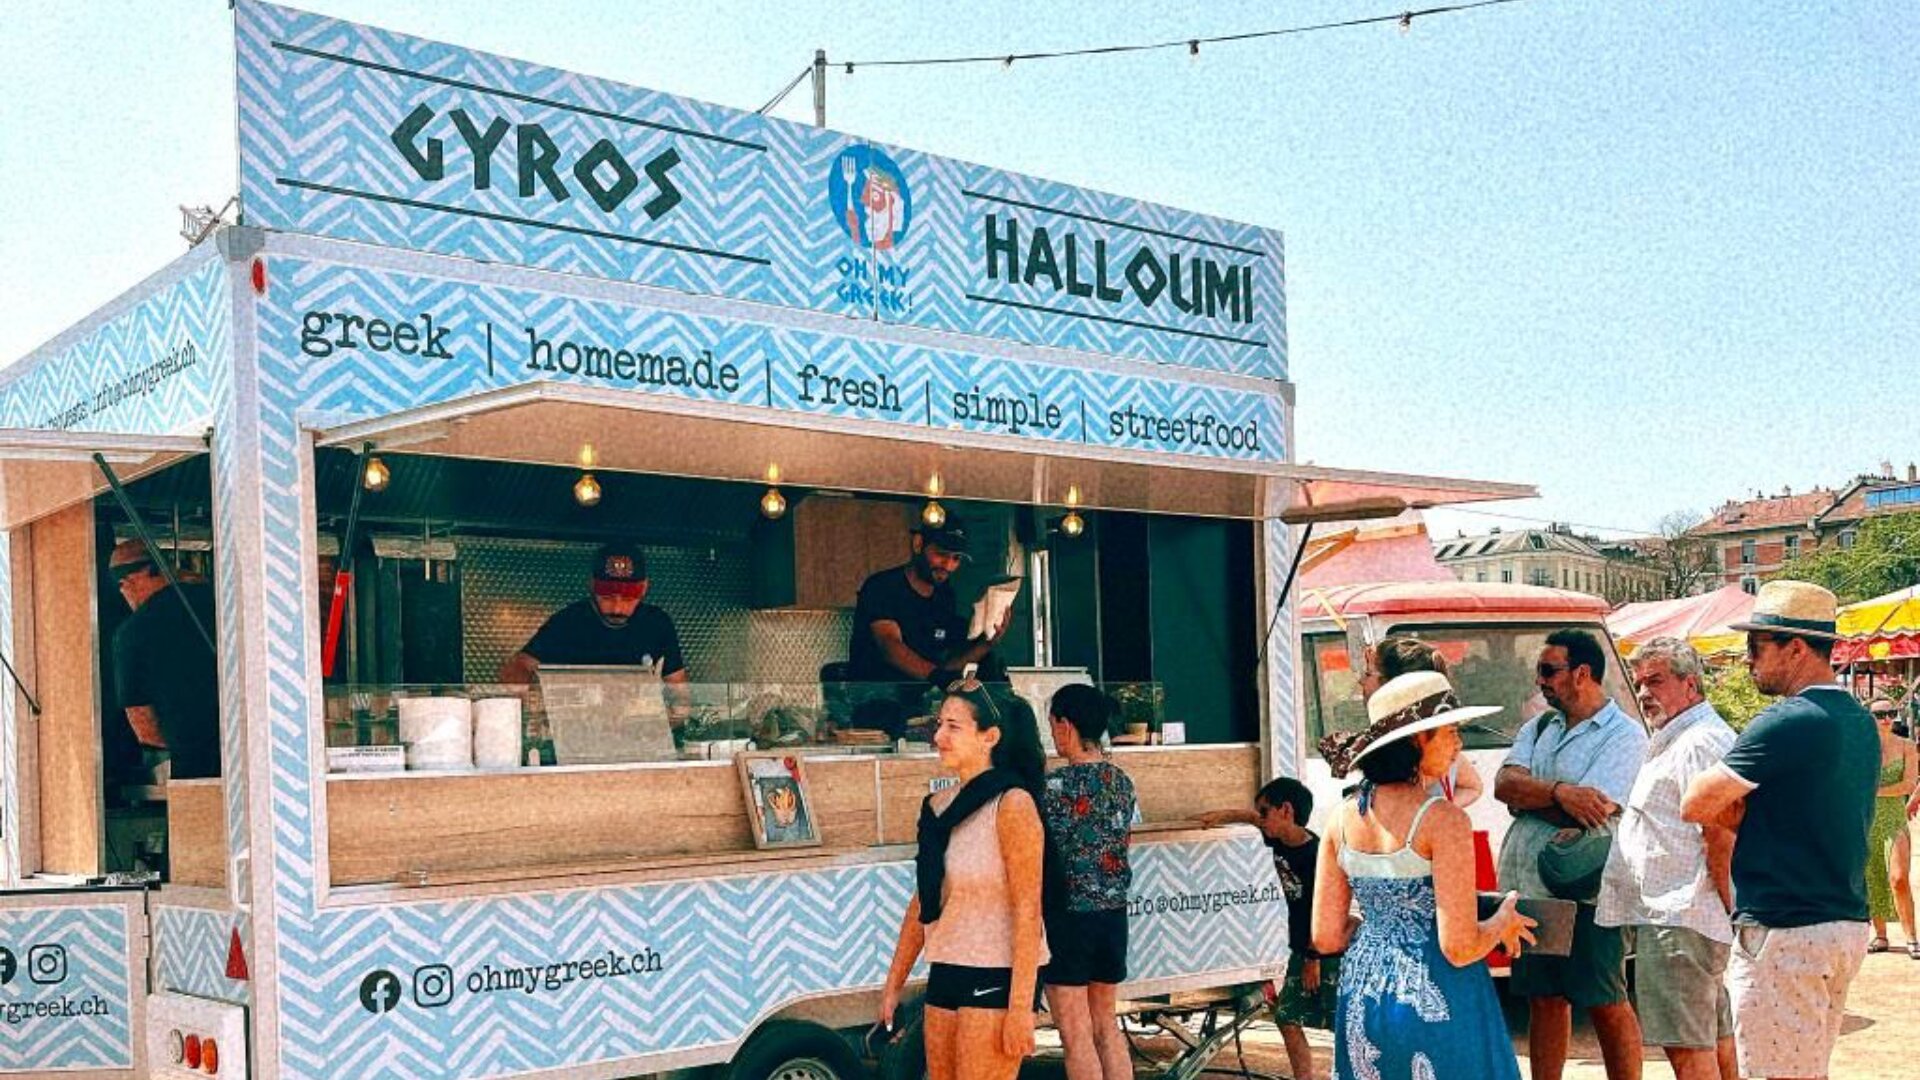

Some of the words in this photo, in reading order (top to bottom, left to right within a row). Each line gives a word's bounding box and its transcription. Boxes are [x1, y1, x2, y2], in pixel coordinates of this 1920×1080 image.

[390, 102, 683, 221] GYROS
[835, 256, 868, 280] OH
[878, 263, 911, 288] MY
[836, 282, 912, 314] GREEK!
[984, 213, 1254, 324] HALLOUMI
[301, 310, 454, 360] greek
[525, 328, 740, 394] homemade
[797, 363, 903, 413] fresh
[952, 386, 1062, 435] simple
[1109, 408, 1261, 452] streetfood
[467, 947, 663, 994] ohmygreek.ch
